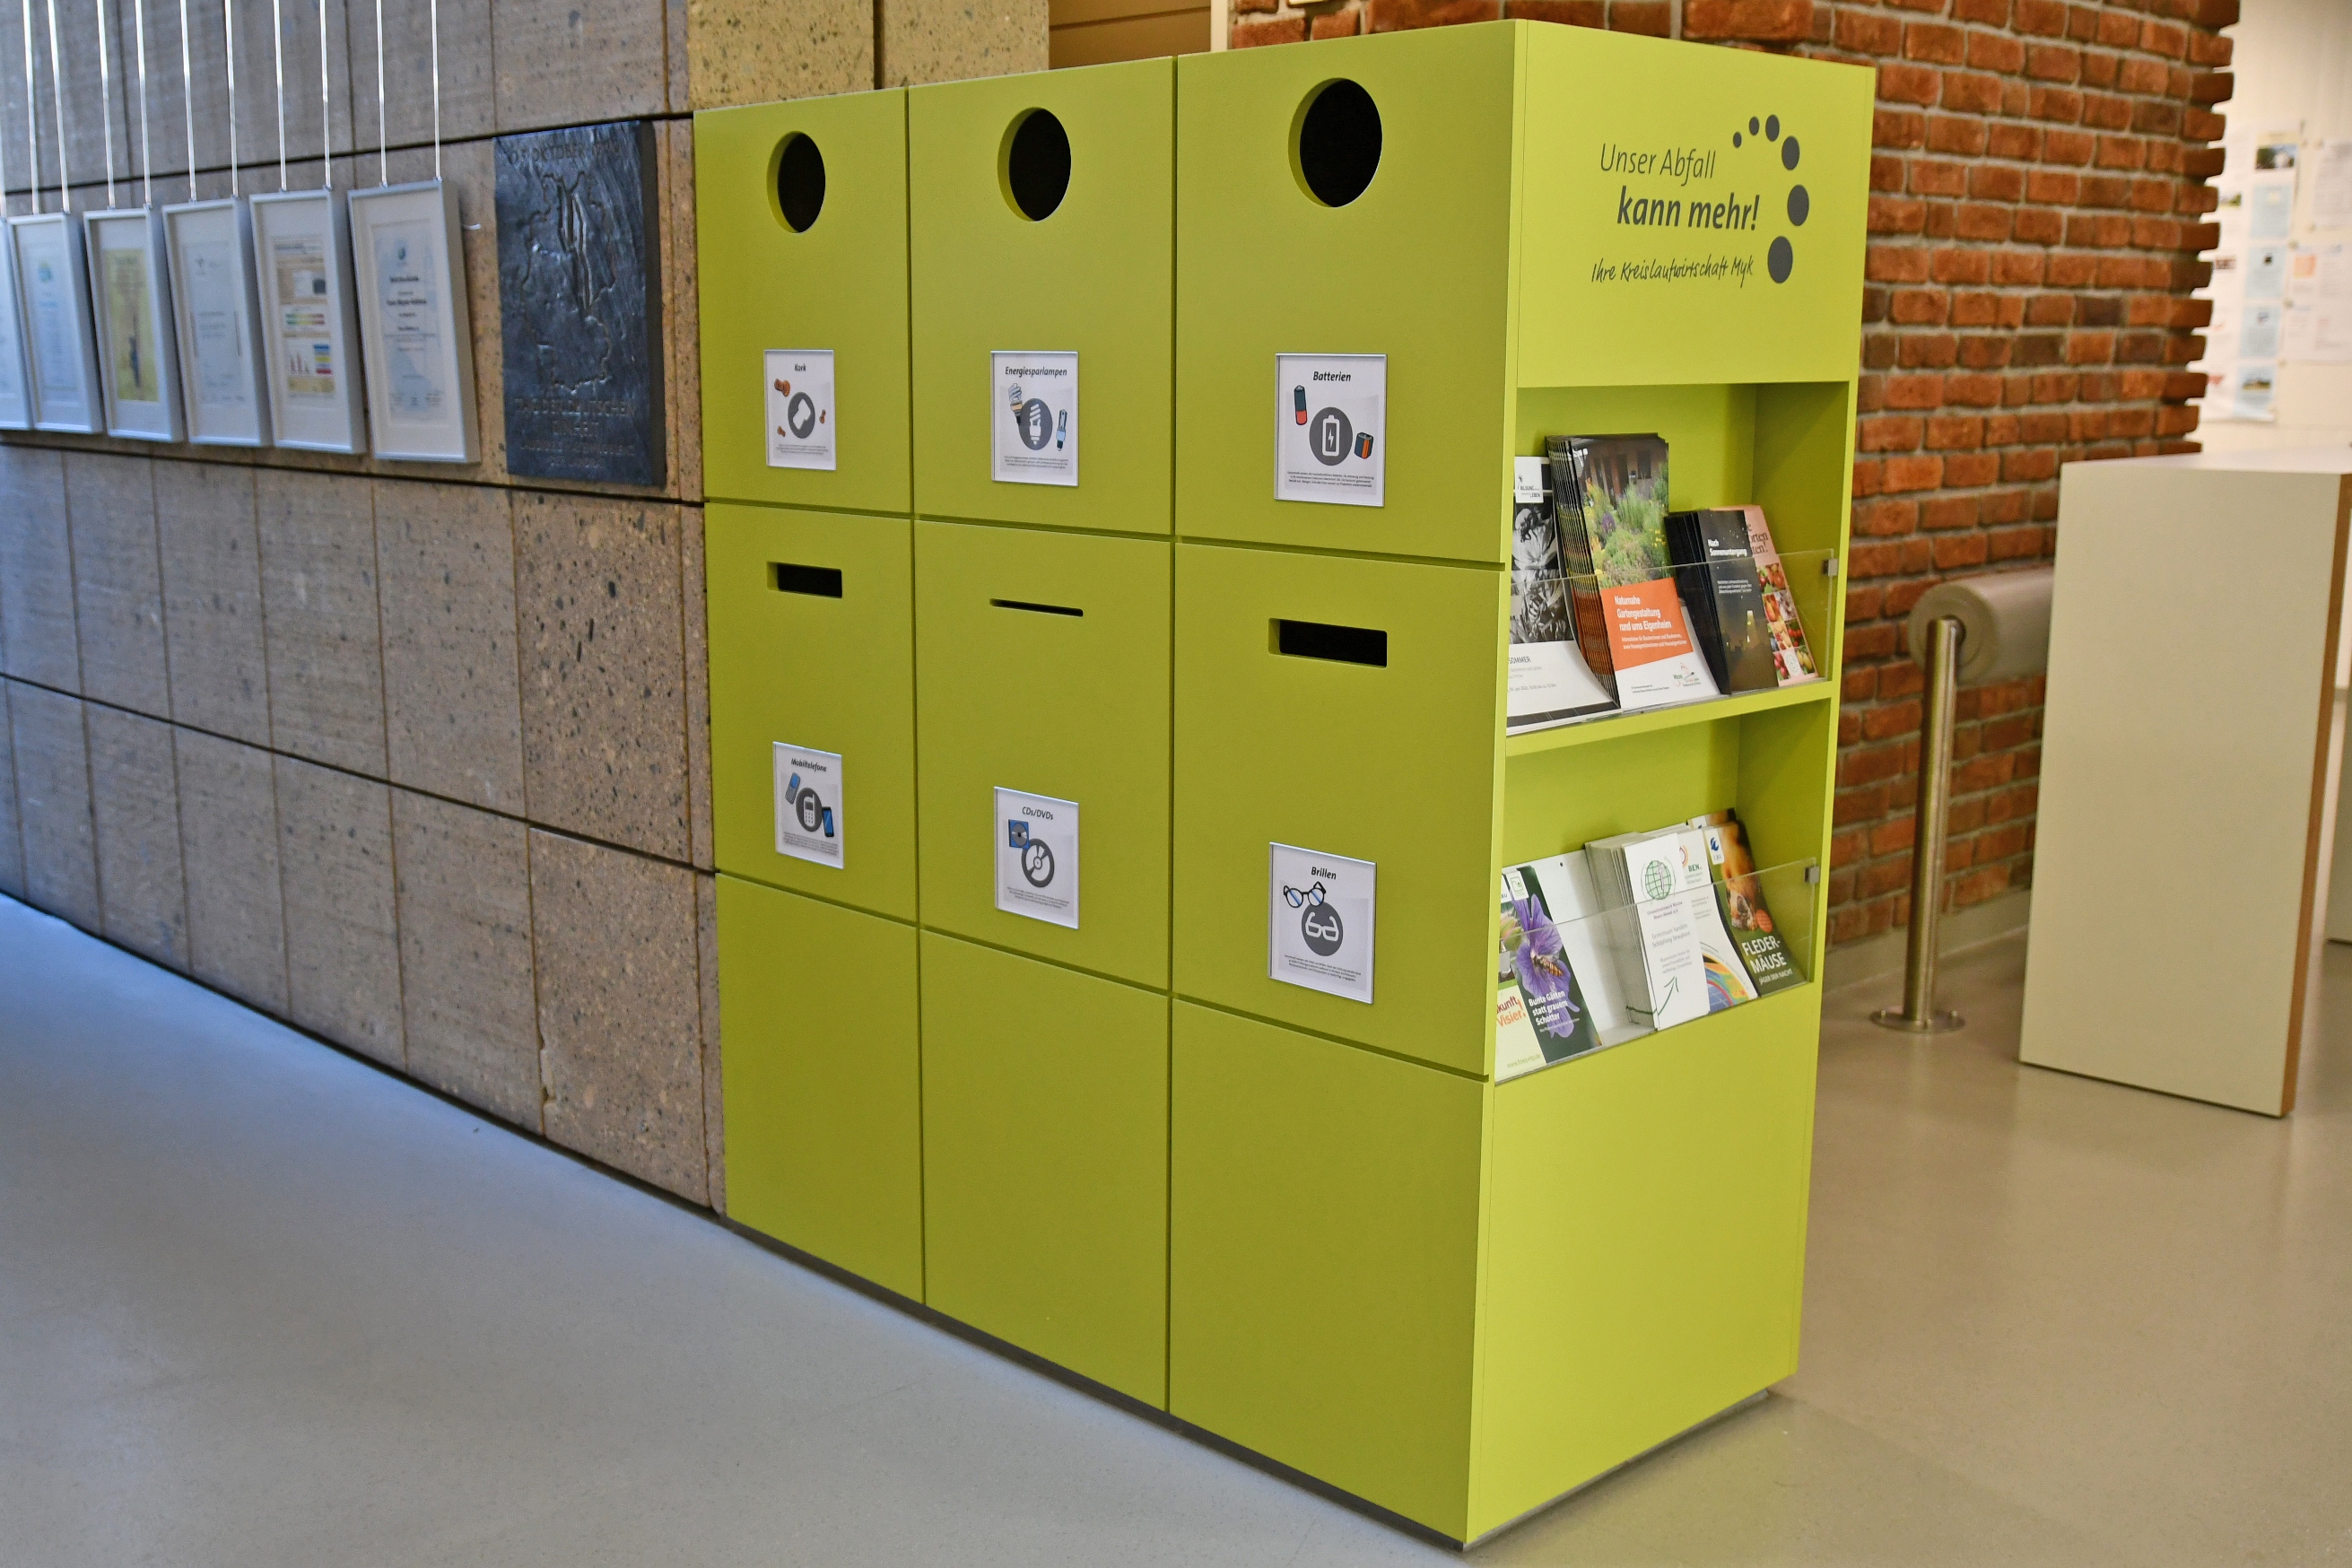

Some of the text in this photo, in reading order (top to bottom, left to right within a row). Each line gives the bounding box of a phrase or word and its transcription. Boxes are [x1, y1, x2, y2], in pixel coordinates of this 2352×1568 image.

[1600, 143, 1716, 187] Unser Abfall
[1616, 185, 1760, 231] kann mehr!
[1591, 257, 1616, 283] Ihre
[1620, 254, 1728, 283] Kreislaufwirtschaft
[794, 363, 806, 371] Kork
[1005, 366, 1067, 379] Energiesparlampen
[1312, 370, 1352, 382] Batterien
[1707, 539, 1720, 547] Nach
[1614, 596, 1641, 605] Naturnahe
[1616, 607, 1661, 620] Gartengestaltung
[1619, 620, 1672, 632] rund ums Eigenheim
[790, 758, 827, 772] Mobiltelefone
[1022, 806, 1054, 820] CDs/DVDs
[1311, 867, 1337, 880] Brillen
[1741, 935, 1781, 956] FLEDER-
[1749, 952, 1788, 974] MÄUSE
[1528, 990, 1566, 1006] Bunte Gärten
[1532, 1000, 1569, 1016] statt grauem
[1535, 1012, 1560, 1026] Schotter
